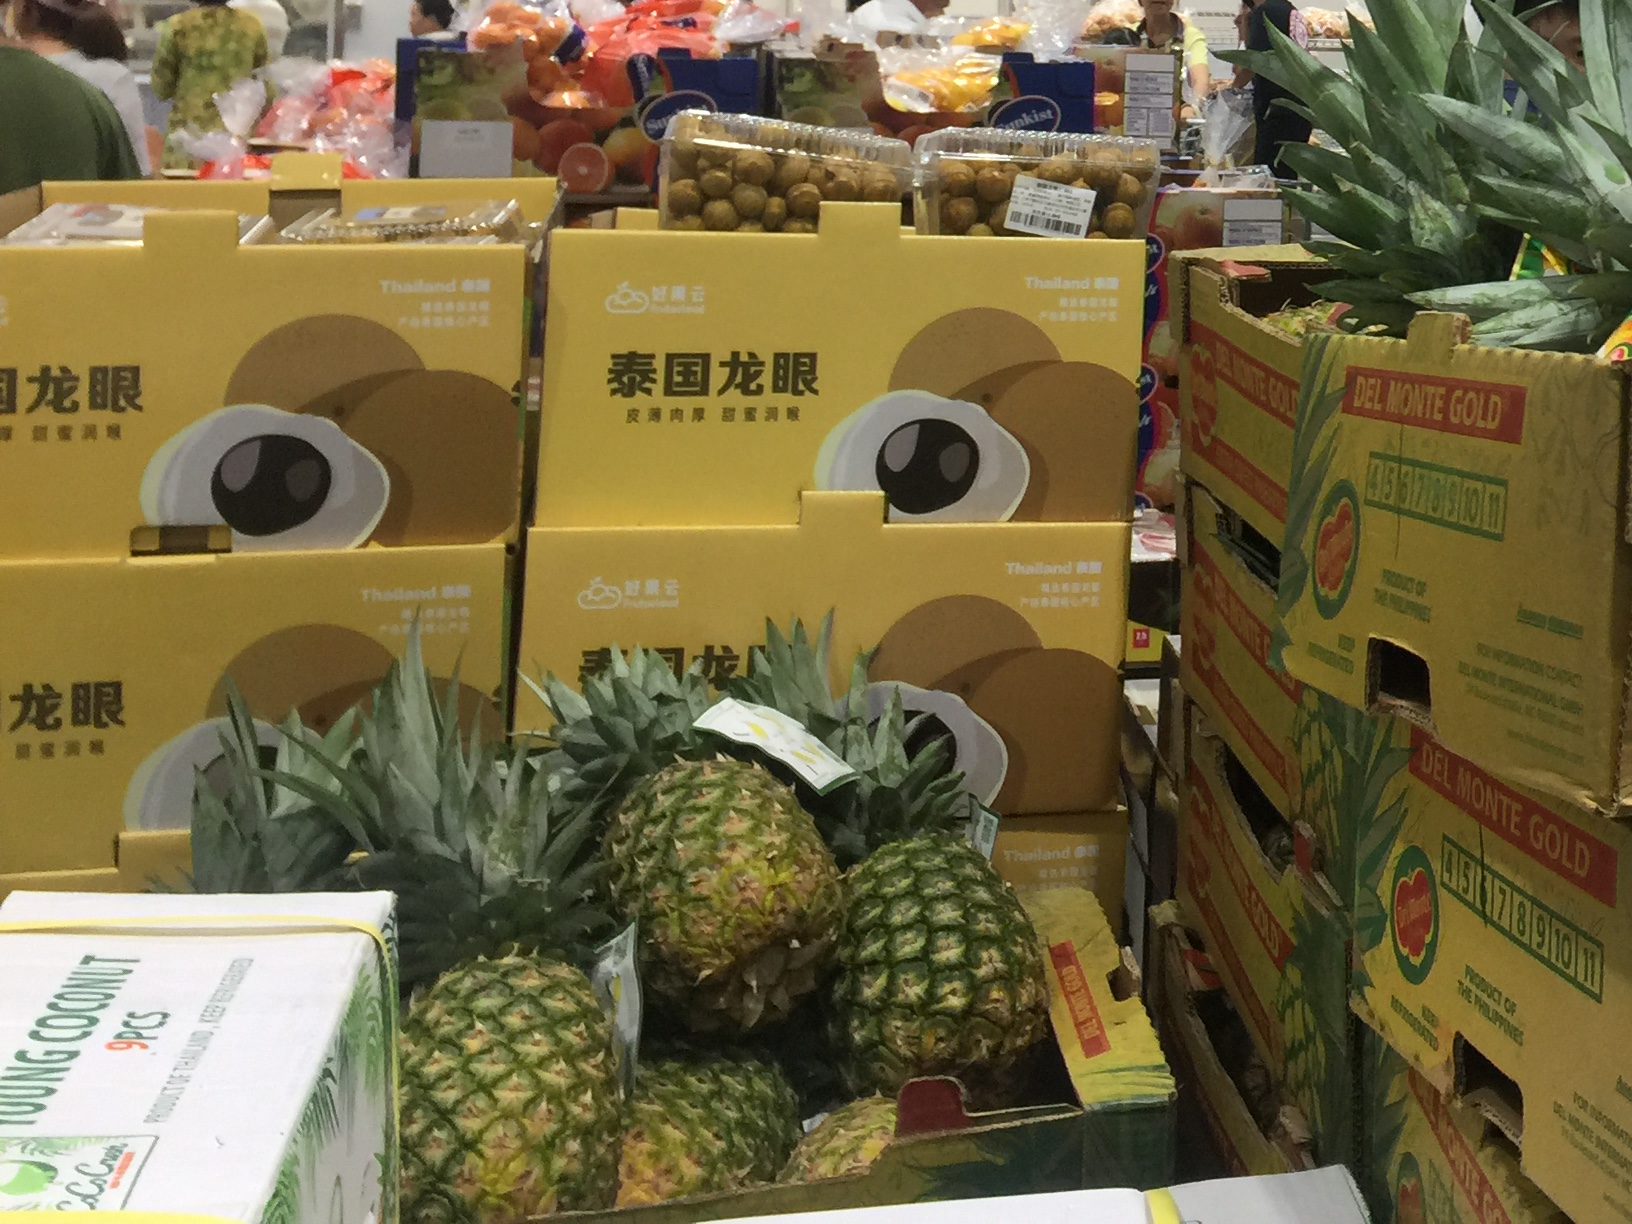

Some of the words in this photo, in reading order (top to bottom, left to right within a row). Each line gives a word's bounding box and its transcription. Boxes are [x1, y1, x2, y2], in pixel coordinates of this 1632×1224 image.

[1024, 276, 1090, 290] Thailand
[607, 351, 819, 398] 泰国龙眼
[1354, 378, 1383, 419] DEL
[1387, 383, 1445, 425] MONTE
[1449, 390, 1502, 431] GOLD
[1005, 561, 1072, 575] Thailand
[1422, 742, 1453, 792] DEL
[1458, 764, 1523, 836] MONTE
[1528, 812, 1592, 877] GOLD
[1445, 849, 1453, 884] 4
[1463, 861, 1471, 896] 5
[1498, 886, 1507, 921] 7
[1517, 900, 1526, 937] 8
[1536, 913, 1545, 950] 9
[1554, 928, 1573, 970] 10
[1583, 947, 1595, 987] 11
[28, 954, 141, 1043] COCONUT
[1458, 979, 1472, 1004] THE
[1474, 994, 1524, 1046] PHILIPPINES
[1465, 964, 1502, 1006] PRODUCT
[1504, 997, 1517, 1017] OF
